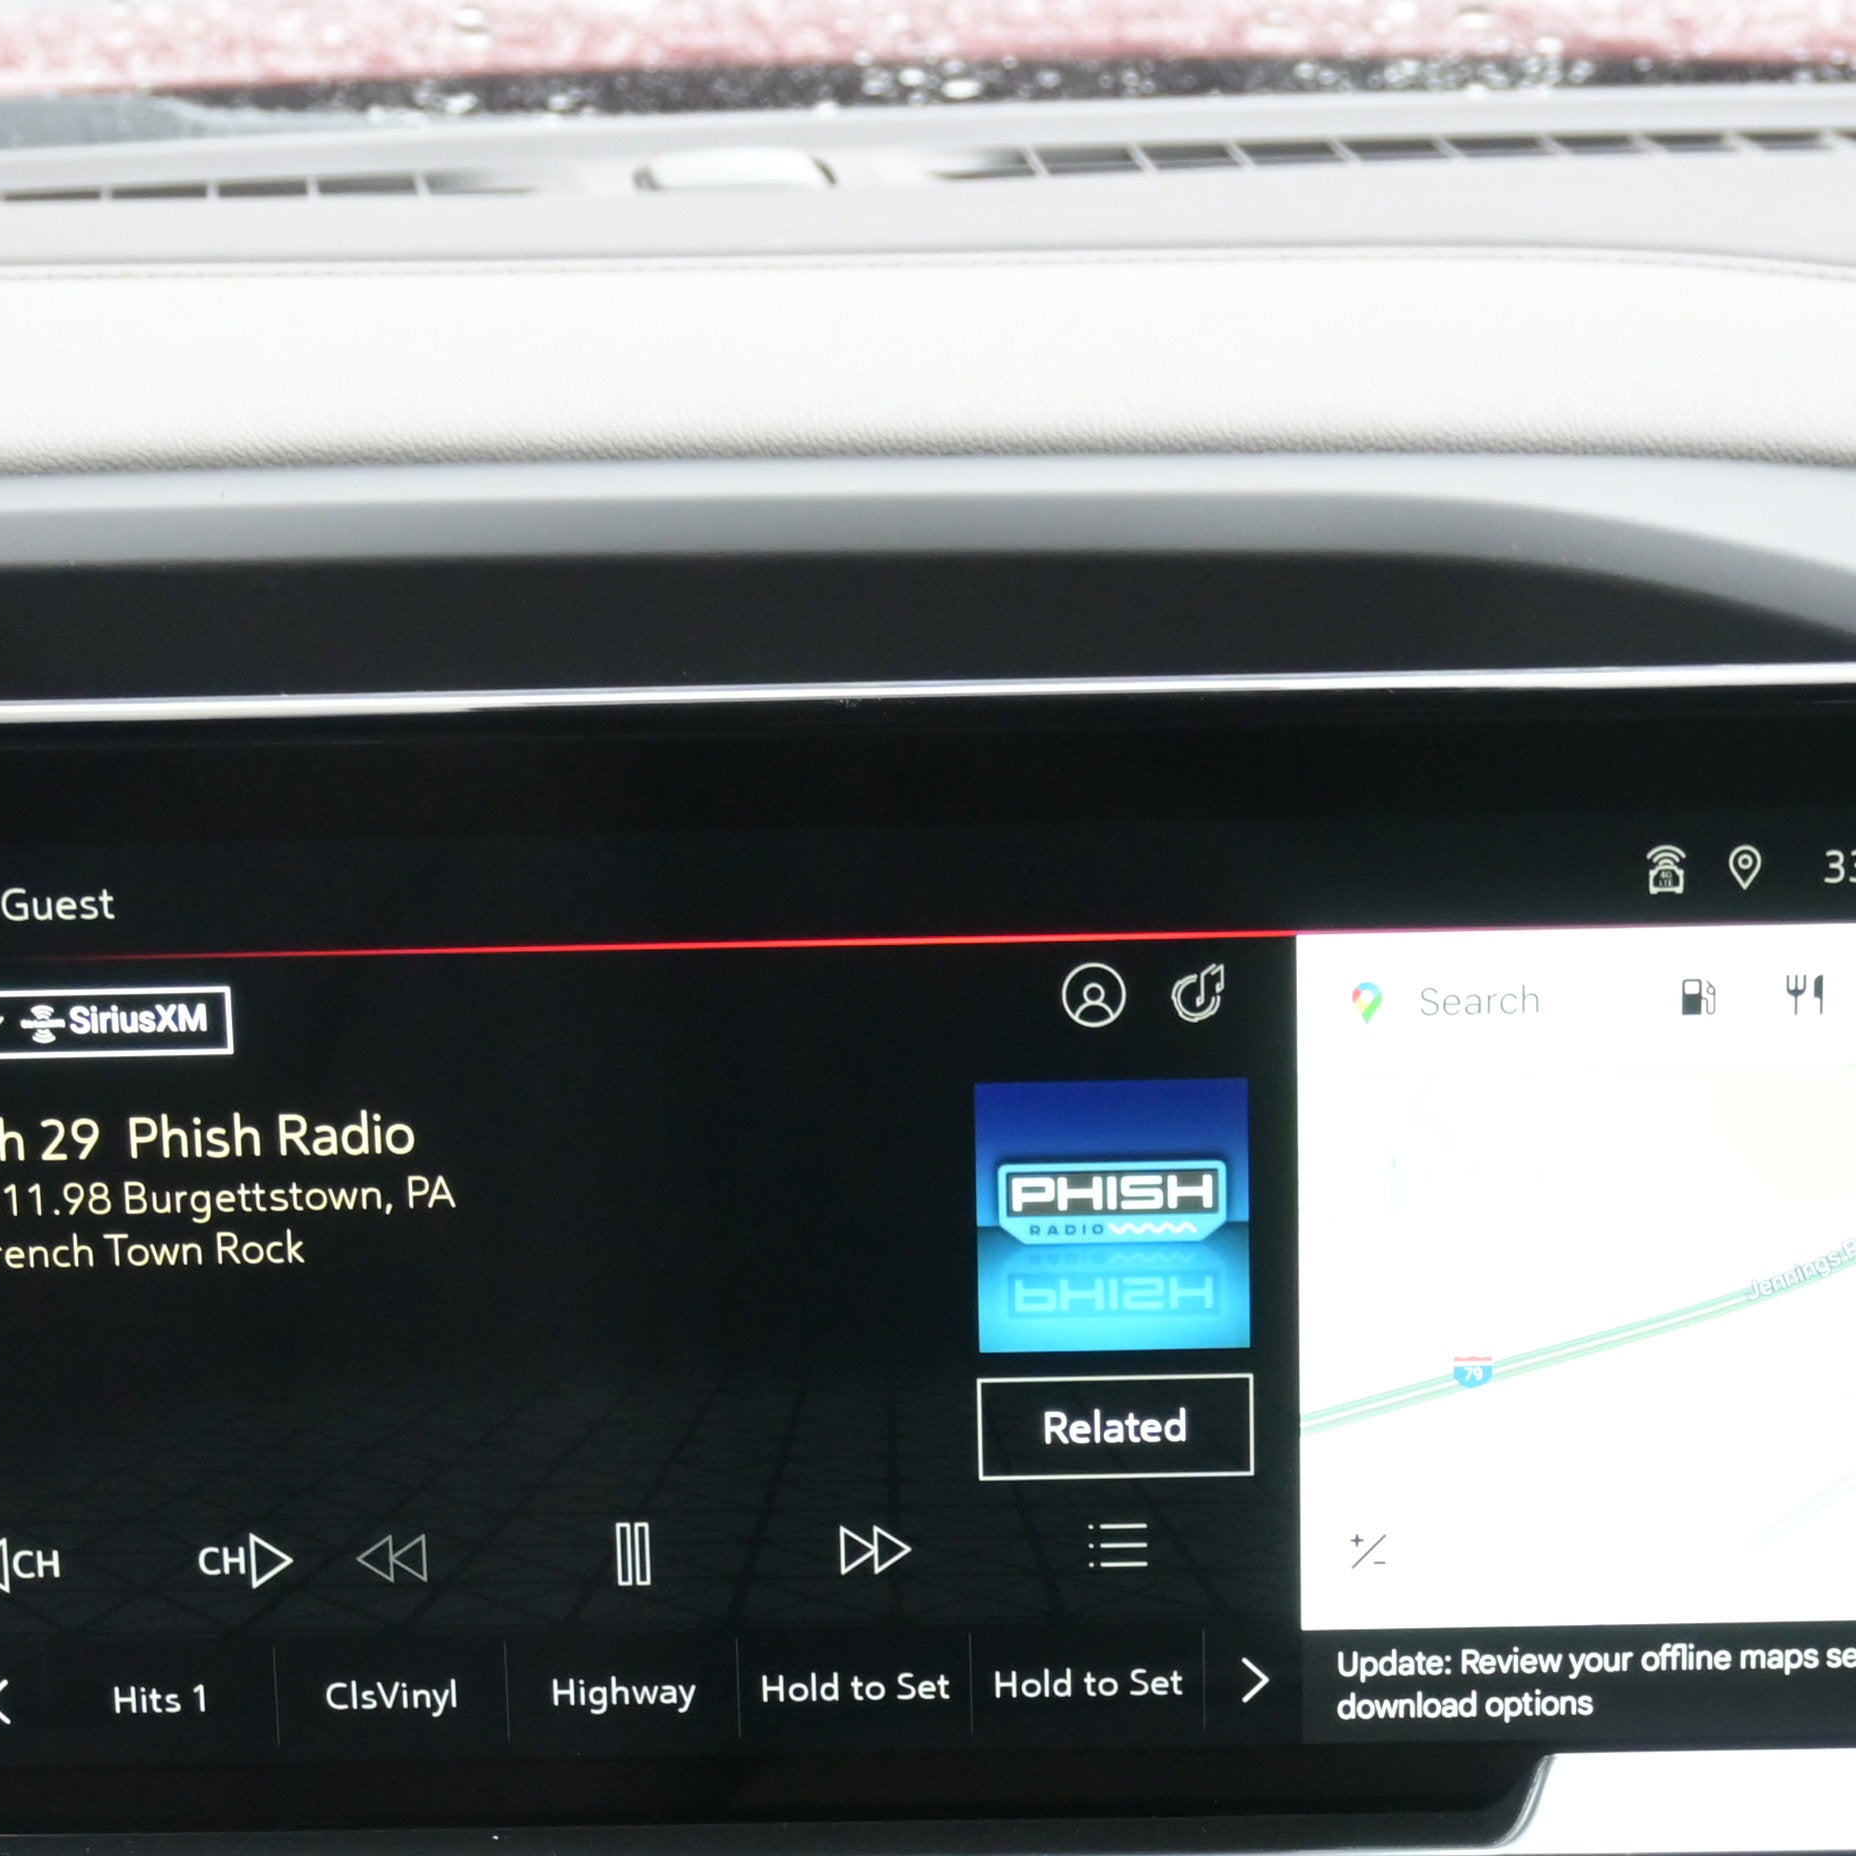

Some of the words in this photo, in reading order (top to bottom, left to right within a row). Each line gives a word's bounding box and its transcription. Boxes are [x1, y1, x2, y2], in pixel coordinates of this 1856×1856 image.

[1, 888, 115, 921] Guest
[1421, 984, 1538, 1016] Search
[69, 1003, 207, 1034] SiriusXM
[41, 1118, 99, 1160] 29
[129, 1112, 260, 1159] Phish
[279, 1109, 414, 1156] Radio
[124, 1181, 392, 1223] Burgettstown,
[408, 1175, 456, 1208] PA
[1012, 1174, 1213, 1212] PHISH
[1029, 1222, 1105, 1236] RADIO
[103, 1234, 202, 1266] Town
[216, 1229, 304, 1264] Rock
[1747, 1251, 1843, 1301] Jennings
[1464, 1366, 1483, 1382] 79
[1044, 1407, 1186, 1444] Related
[13, 1550, 60, 1578] CH
[199, 1547, 245, 1575] CH
[1338, 1648, 1451, 1683] Update:
[1461, 1646, 1563, 1674] Review
[1569, 1651, 1634, 1679] your
[1641, 1643, 1732, 1671] offline
[1740, 1648, 1819, 1675] maps
[114, 1686, 181, 1713] Hits
[194, 1684, 205, 1712] 1
[326, 1679, 456, 1717] ClsVinyl
[553, 1676, 696, 1714] Highway
[762, 1672, 839, 1702] Hold
[851, 1676, 885, 1700] to
[897, 1673, 950, 1700] Set
[995, 1668, 1071, 1698] Hold
[1084, 1672, 1118, 1696] to
[1130, 1669, 1183, 1696] Set
[1337, 1690, 1477, 1720] download
[1485, 1689, 1593, 1723] options
